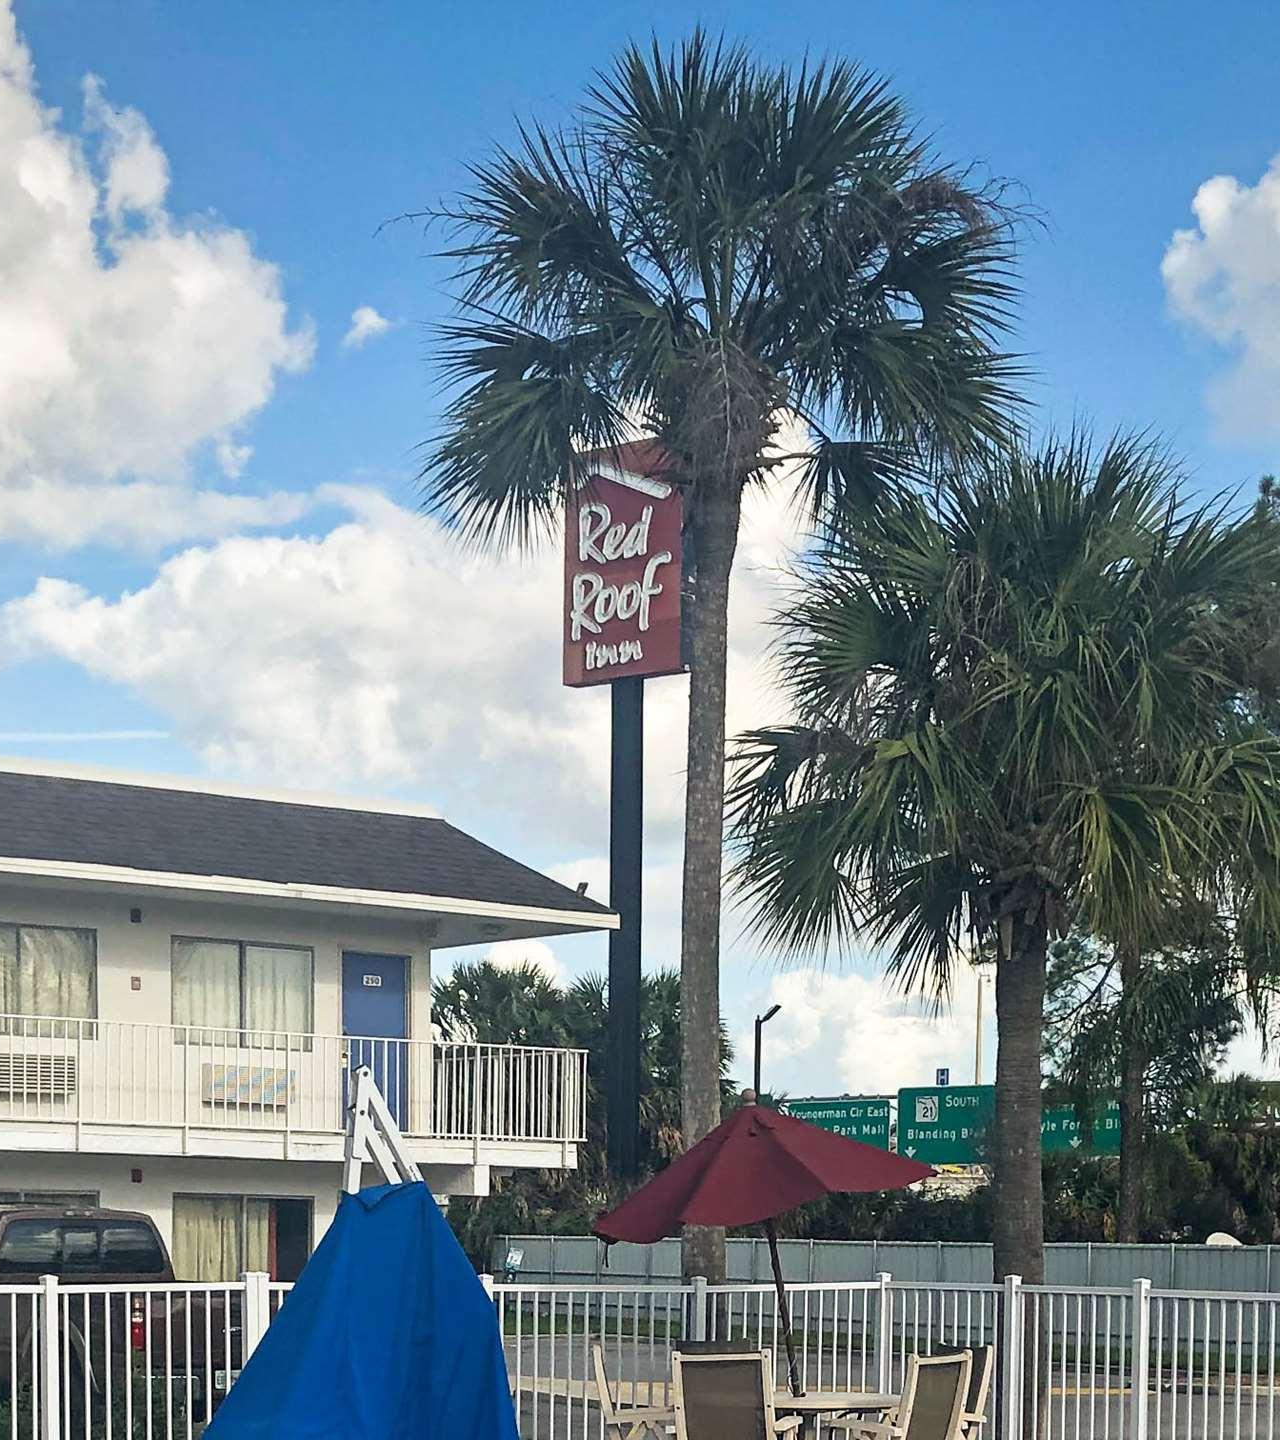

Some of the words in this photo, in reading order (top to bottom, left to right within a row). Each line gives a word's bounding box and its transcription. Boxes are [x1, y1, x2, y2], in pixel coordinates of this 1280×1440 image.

[579, 503, 653, 564] Red
[570, 550, 672, 642] Roof
[850, 1107, 863, 1117] Cir
[868, 1107, 888, 1117] East
[833, 1125, 857, 1136] Park
[863, 1125, 885, 1135] Mall
[907, 1128, 956, 1141] Blanding
